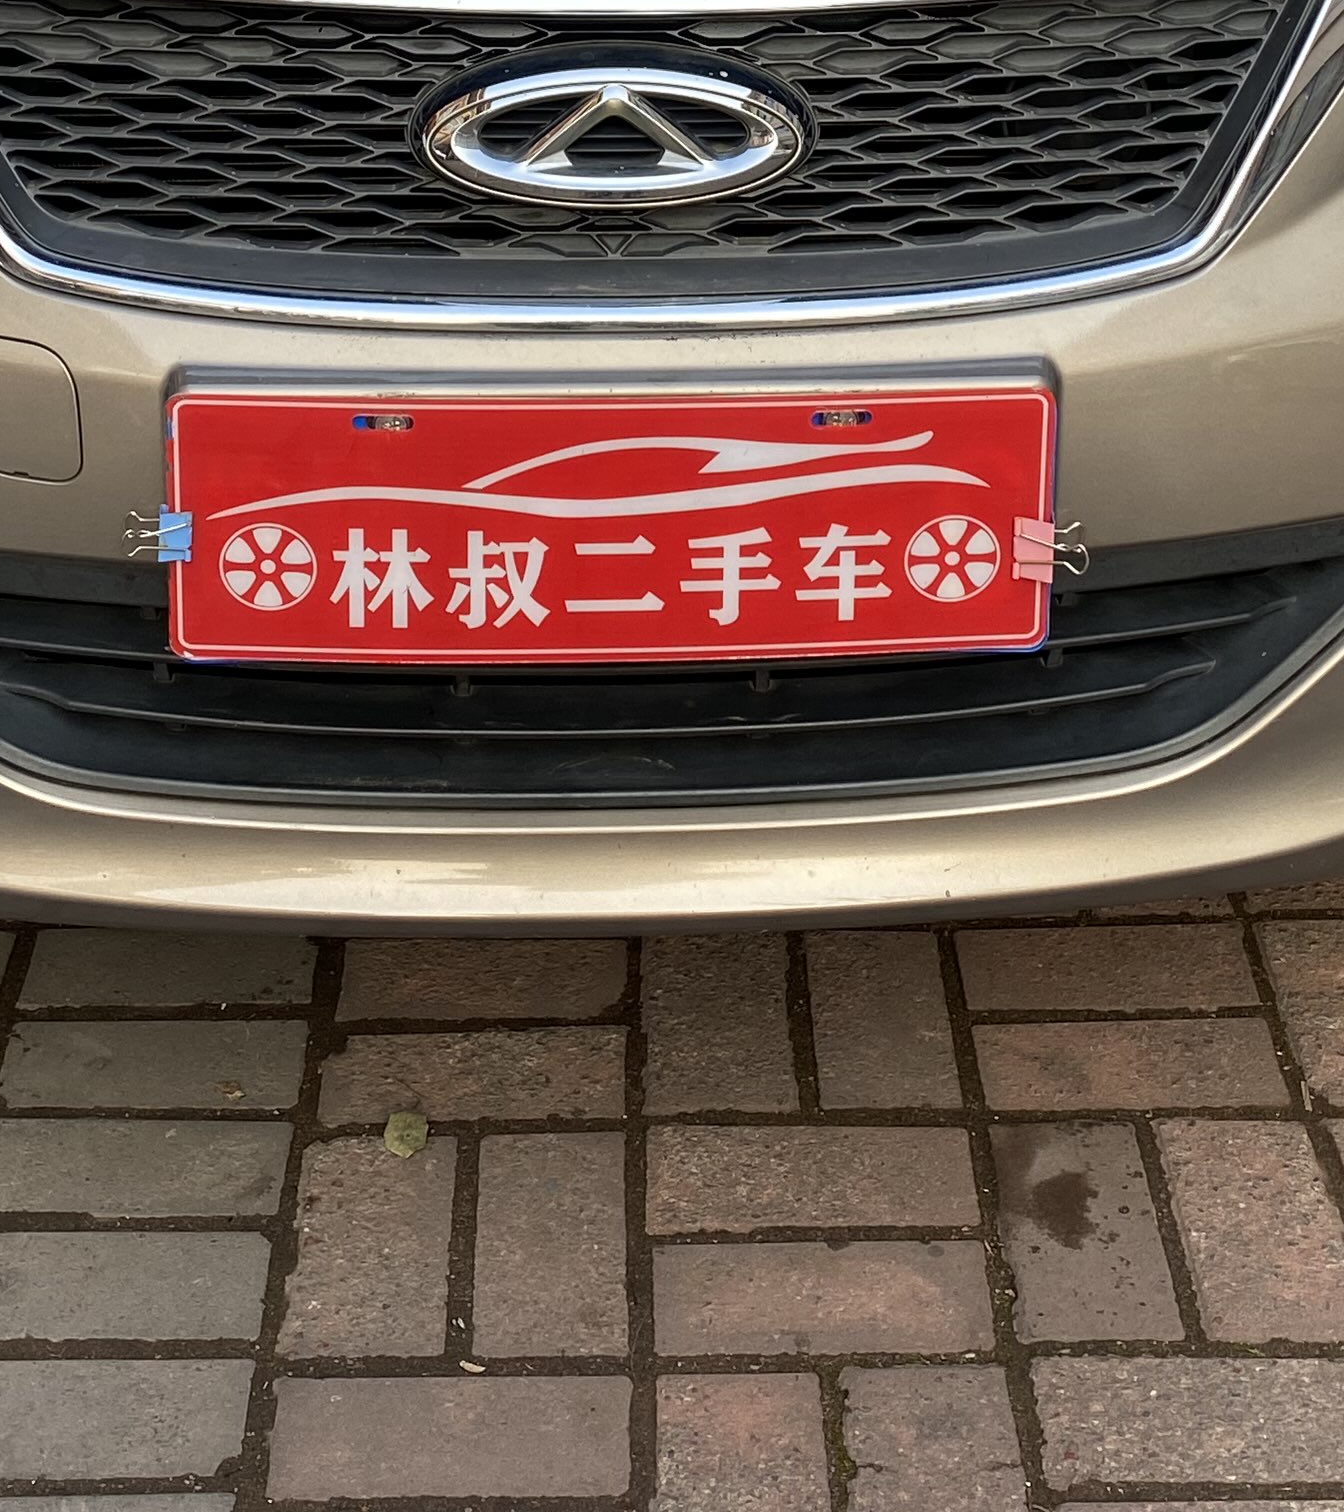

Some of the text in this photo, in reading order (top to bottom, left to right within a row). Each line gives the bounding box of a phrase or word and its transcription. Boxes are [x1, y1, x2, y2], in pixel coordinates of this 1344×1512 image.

[329, 524, 893, 630] 林叔二手车
